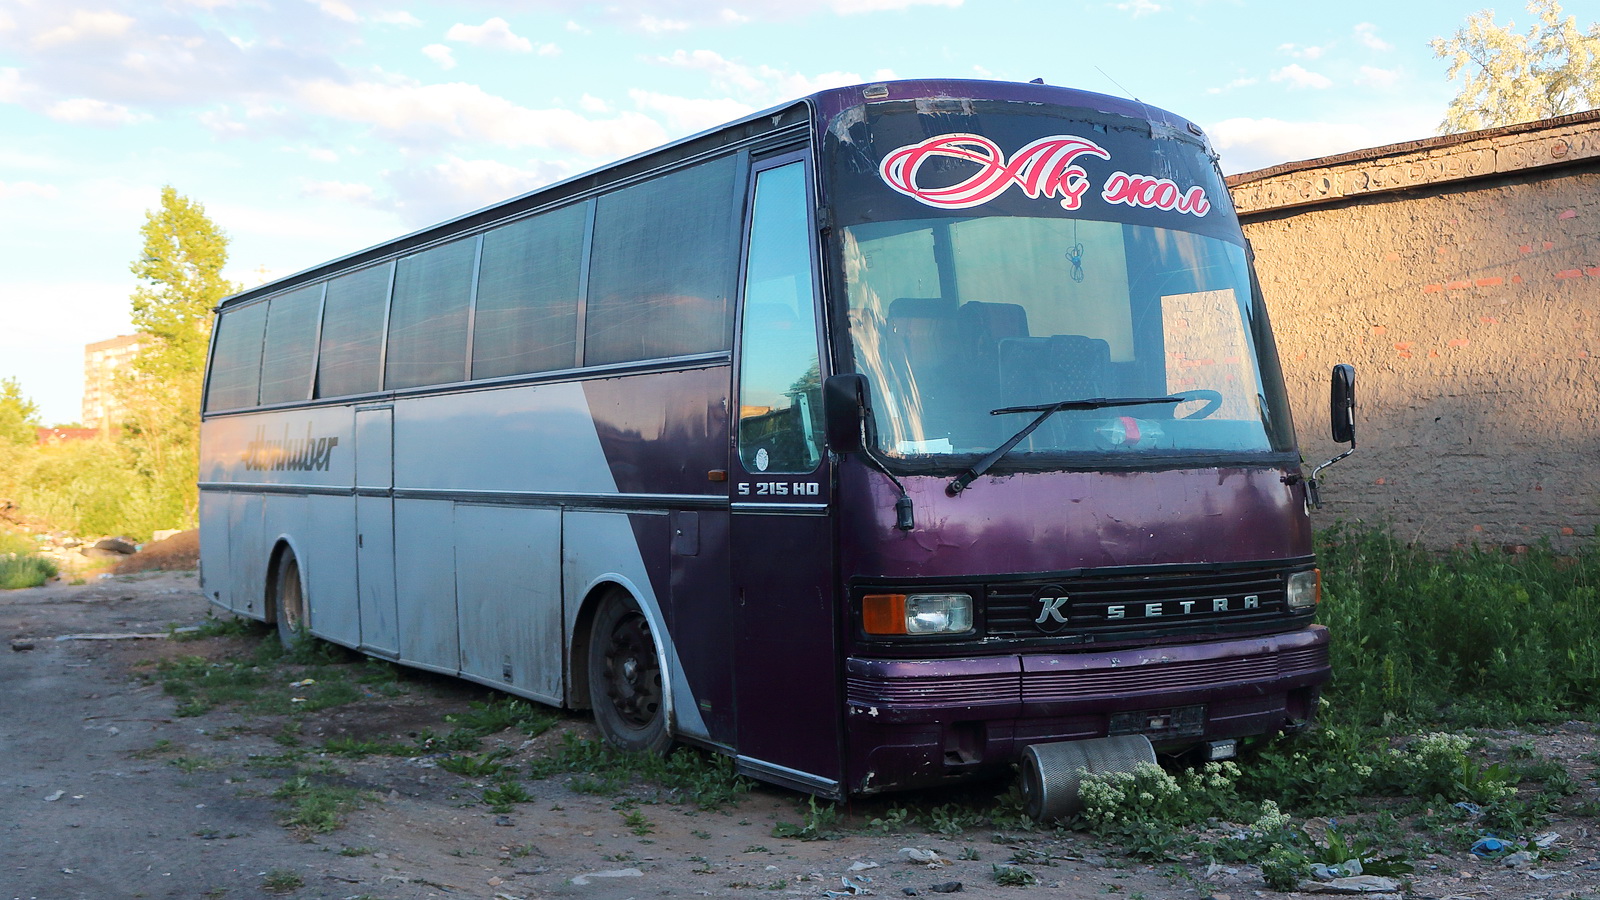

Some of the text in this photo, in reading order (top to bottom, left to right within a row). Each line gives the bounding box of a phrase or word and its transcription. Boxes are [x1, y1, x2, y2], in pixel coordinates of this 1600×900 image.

[1102, 171, 1210, 217] жол
[738, 482, 819, 495] S 215 HD
[1035, 597, 1069, 623] K
[1107, 595, 1259, 619] SETRA
